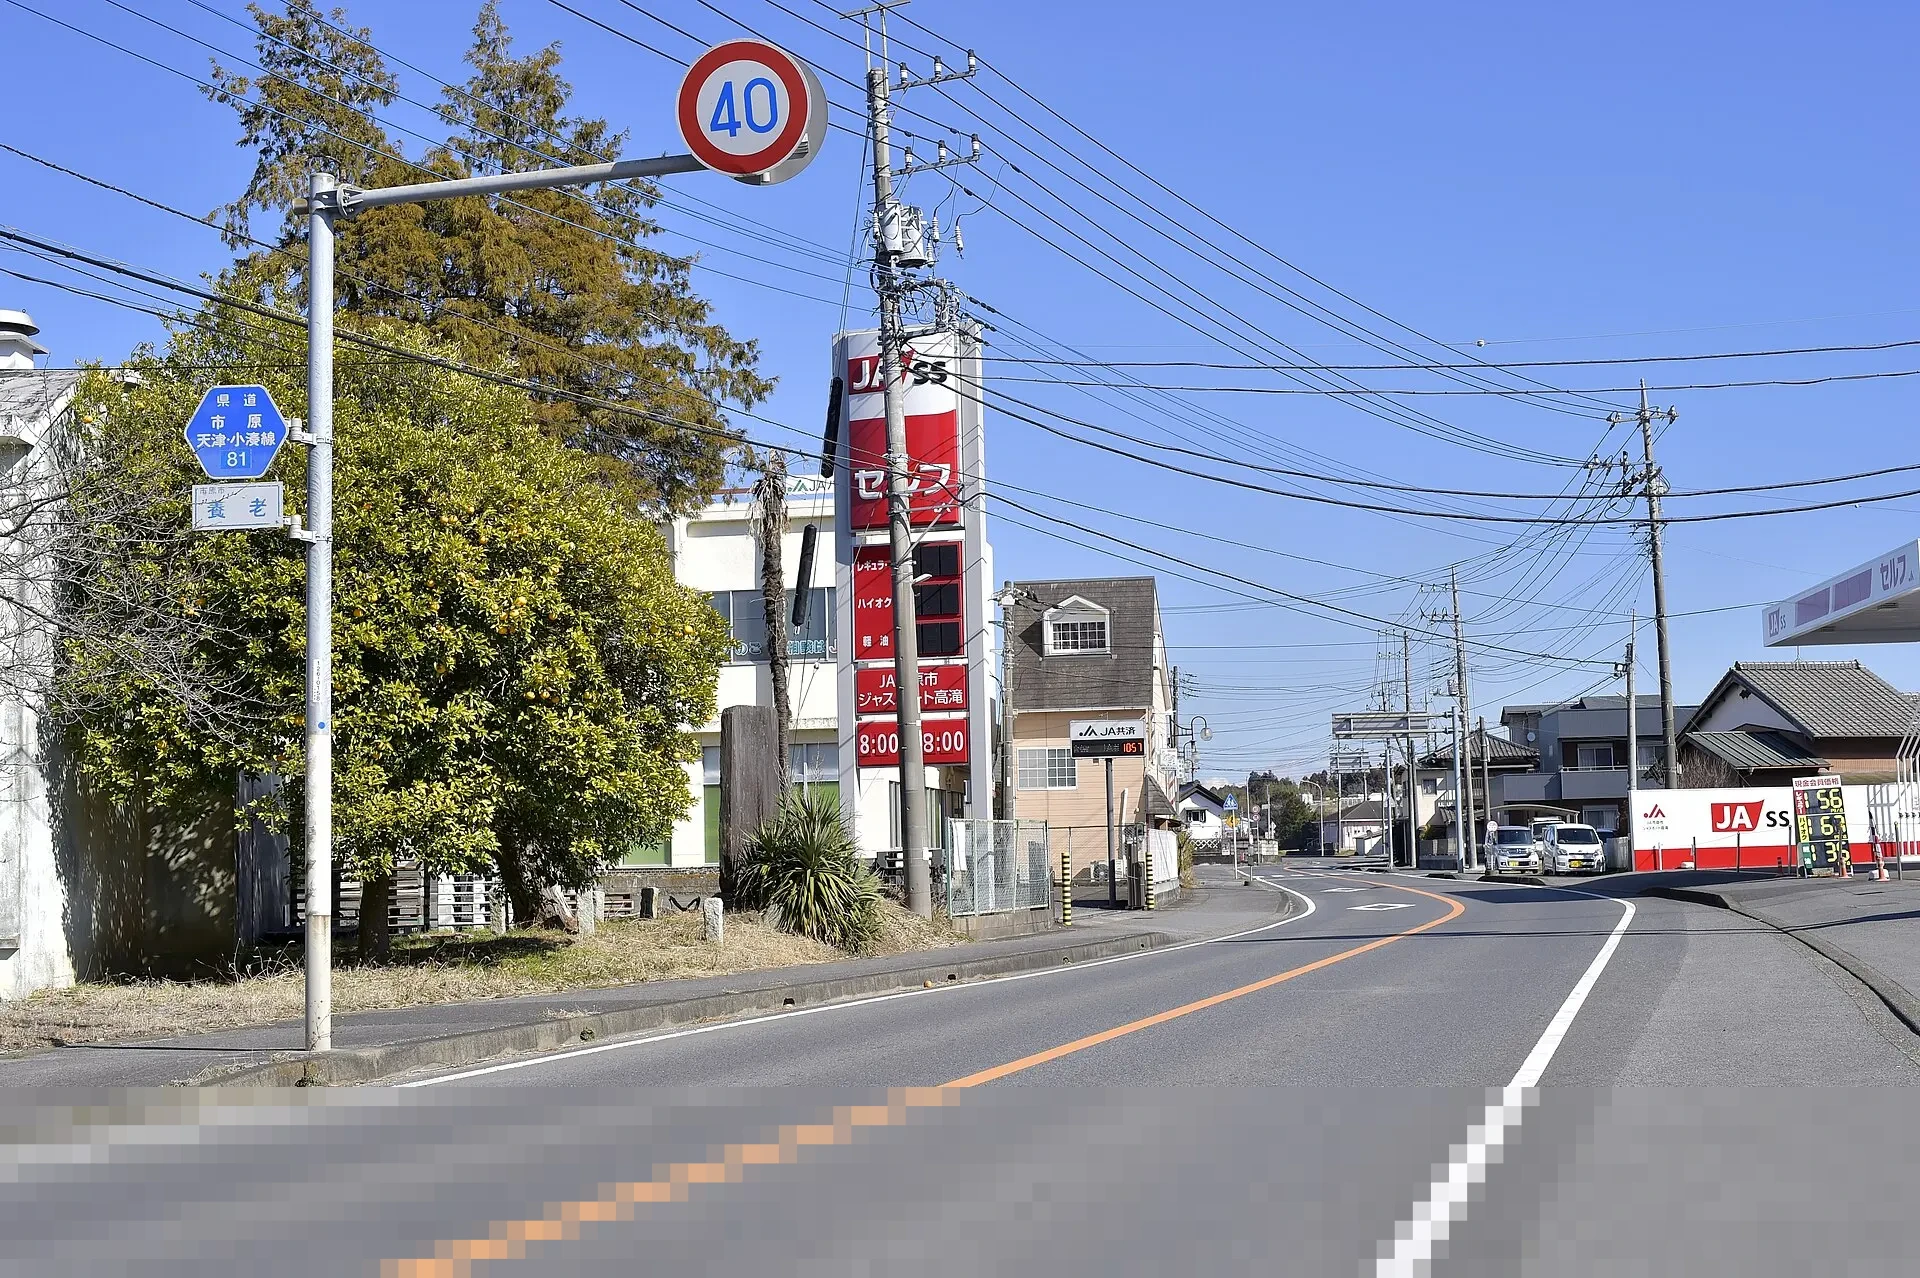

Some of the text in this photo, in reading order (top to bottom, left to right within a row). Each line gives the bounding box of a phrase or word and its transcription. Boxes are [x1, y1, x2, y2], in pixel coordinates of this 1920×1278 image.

[709, 77, 779, 138] 40
[216, 393, 257, 408] 県道
[210, 413, 263, 431] 市原
[226, 451, 247, 467] 81
[207, 498, 268, 519] 養老
[857, 559, 888, 572] レギュラ
[1880, 554, 1907, 591] セルフ
[857, 597, 892, 610] ハイオク
[862, 634, 890, 648] 軽油
[879, 672, 939, 688] JA市
[858, 689, 963, 708] ジャスト高滝
[1100, 726, 1136, 737] JA共済
[859, 732, 899, 755] 8:00
[1804, 788, 1843, 810] 156
[1716, 805, 1790, 829] JA SS
[1799, 816, 1808, 840] ハイオク
